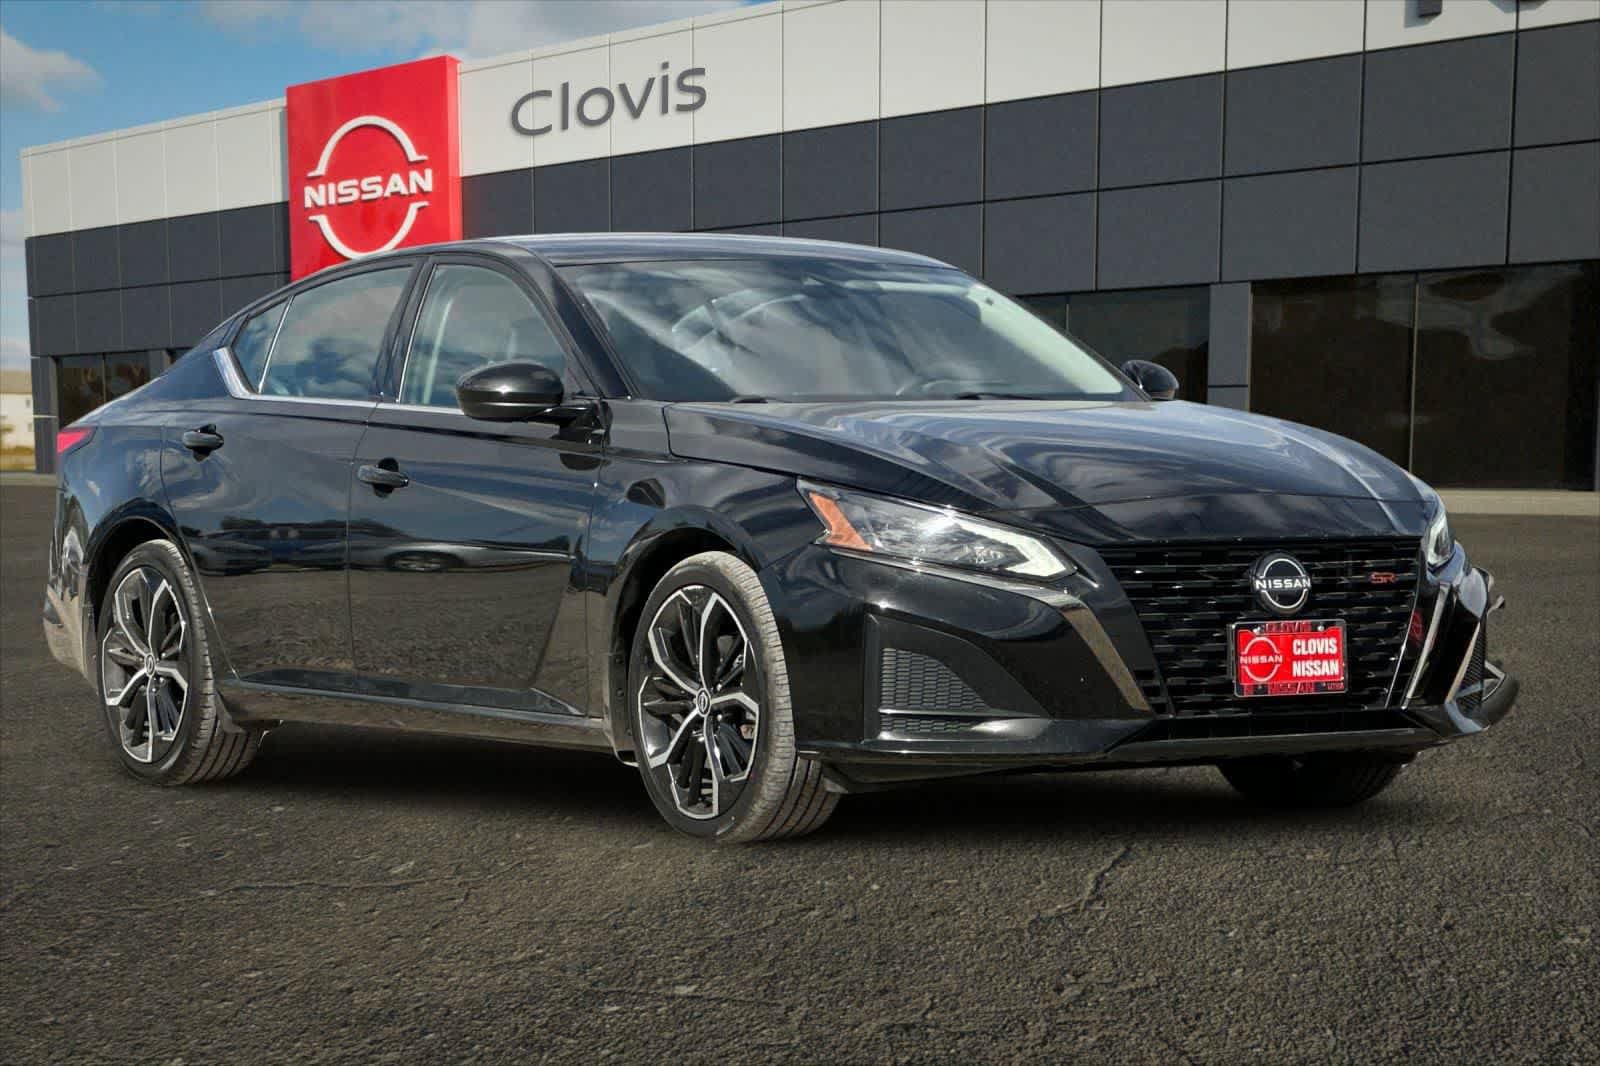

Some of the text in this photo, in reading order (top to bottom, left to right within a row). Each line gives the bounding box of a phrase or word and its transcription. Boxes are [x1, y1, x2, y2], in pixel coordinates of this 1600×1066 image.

[511, 62, 708, 136] Clovis
[303, 168, 433, 210] NISSAN
[1255, 578, 1311, 590] NISSAN
[1369, 572, 1397, 584] SR
[1292, 637, 1338, 656] CLOVIS
[1240, 655, 1283, 665] NISSAN
[1292, 659, 1339, 678] NISSAN
